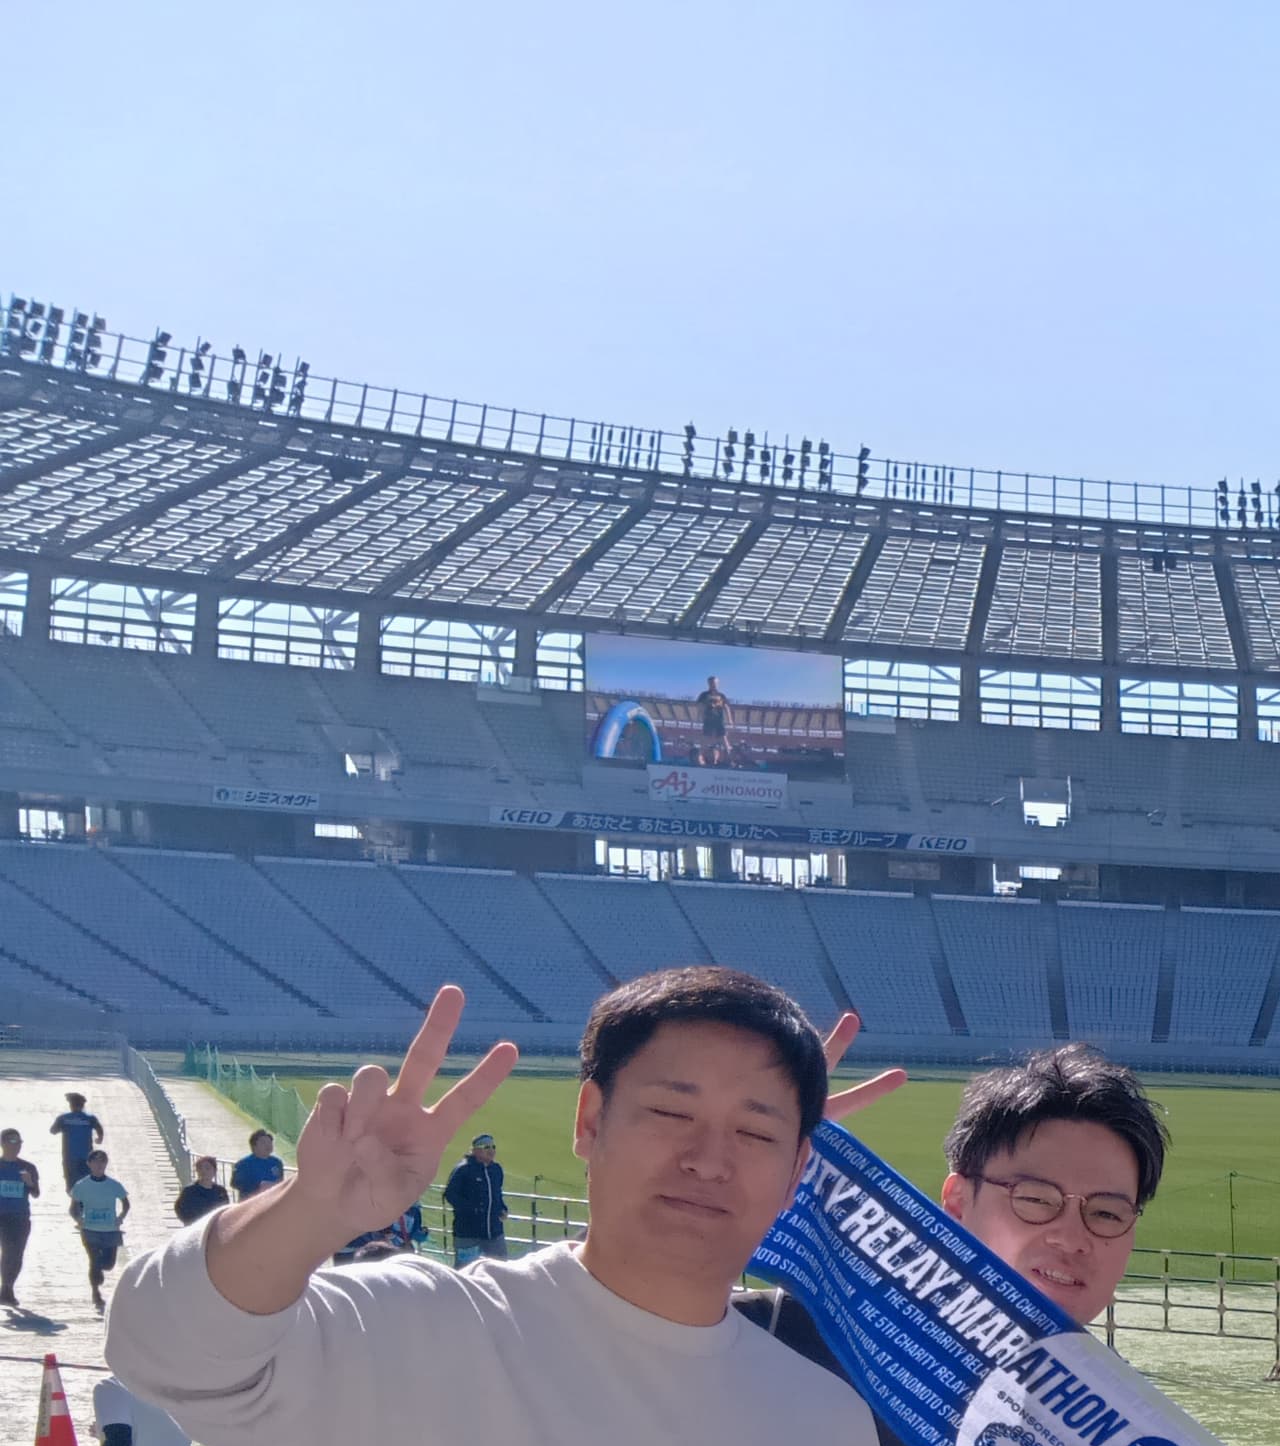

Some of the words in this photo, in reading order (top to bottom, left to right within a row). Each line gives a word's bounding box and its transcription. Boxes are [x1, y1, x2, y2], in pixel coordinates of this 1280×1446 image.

[702, 783, 783, 799] AJINOMOTO
[500, 810, 552, 825] KEIO
[572, 814, 632, 831] あなたと
[638, 818, 714, 836] あたらしい
[718, 823, 779, 840] あしたへ
[808, 828, 898, 848] 京王グループ
[918, 836, 967, 850] KEIO
[877, 1177, 936, 1228] AJINOMOTO
[929, 1221, 977, 1264] STADIUM
[838, 1199, 963, 1299] RELAY
[839, 1246, 882, 1288] STADIUM
[883, 1287, 906, 1312] THE
[922, 1320, 968, 1359] CHARITY
